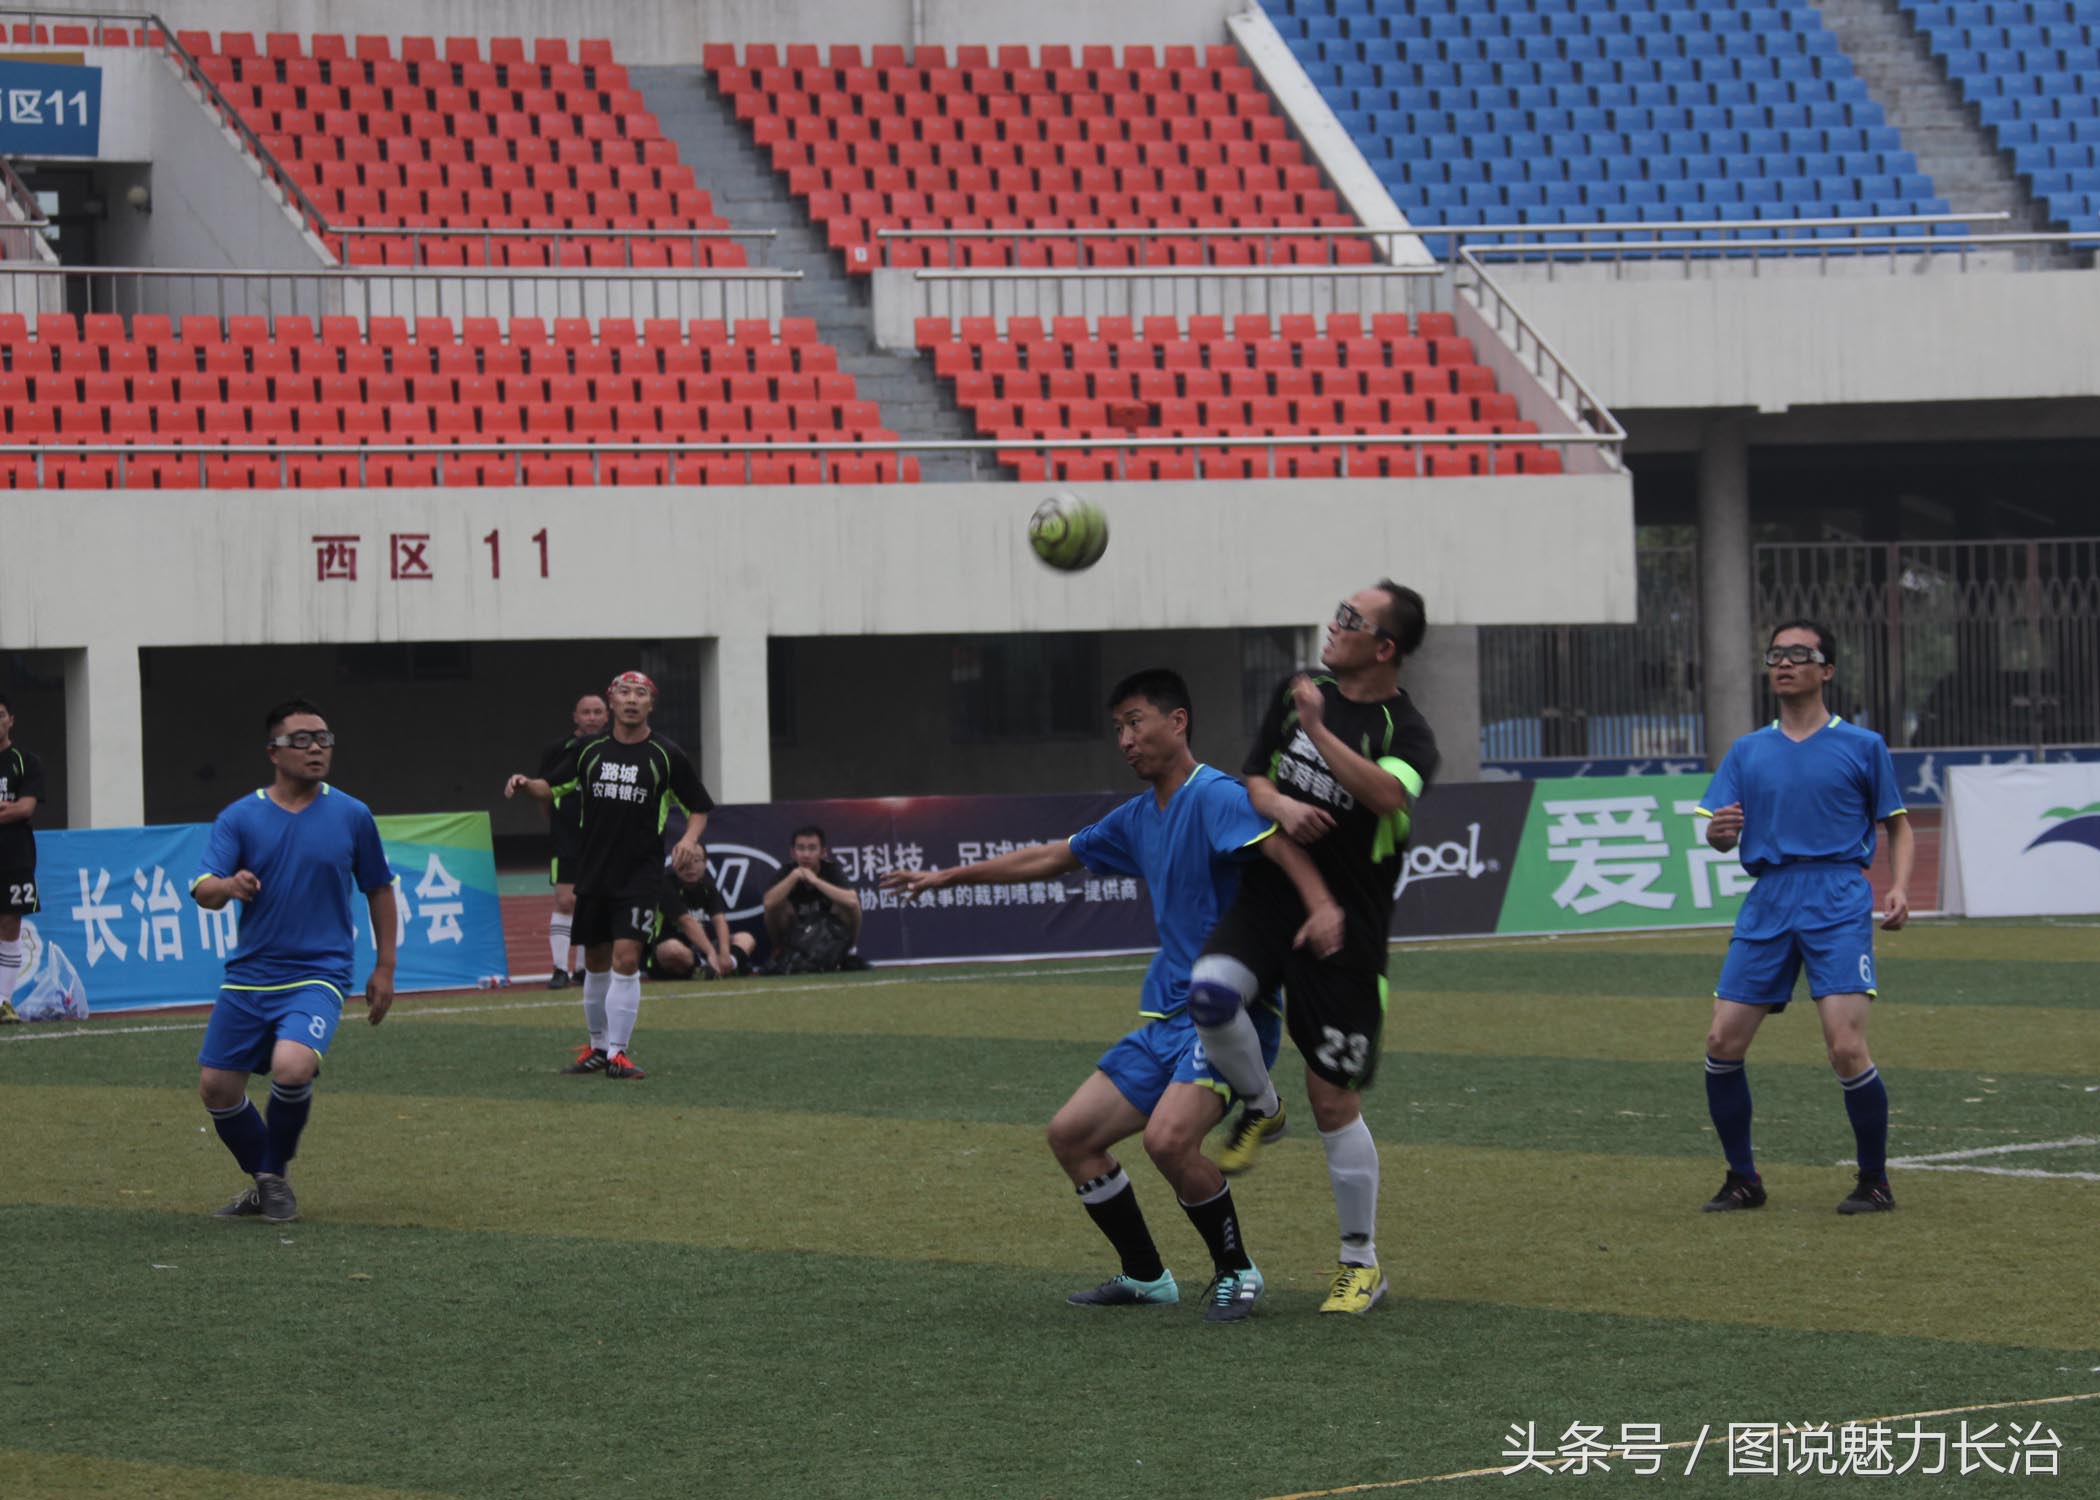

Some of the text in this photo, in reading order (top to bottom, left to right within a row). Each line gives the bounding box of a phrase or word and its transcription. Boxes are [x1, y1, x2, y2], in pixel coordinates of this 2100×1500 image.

[0, 88, 87, 126] 区11
[312, 528, 549, 582] 西区 11
[600, 762, 639, 784] 潞城
[592, 782, 648, 804] 农商银行
[10, 882, 35, 905] 22
[631, 906, 655, 933] 12
[1859, 954, 1872, 983] 6
[308, 1015, 327, 1040] 8
[1317, 1025, 1370, 1074] 23
